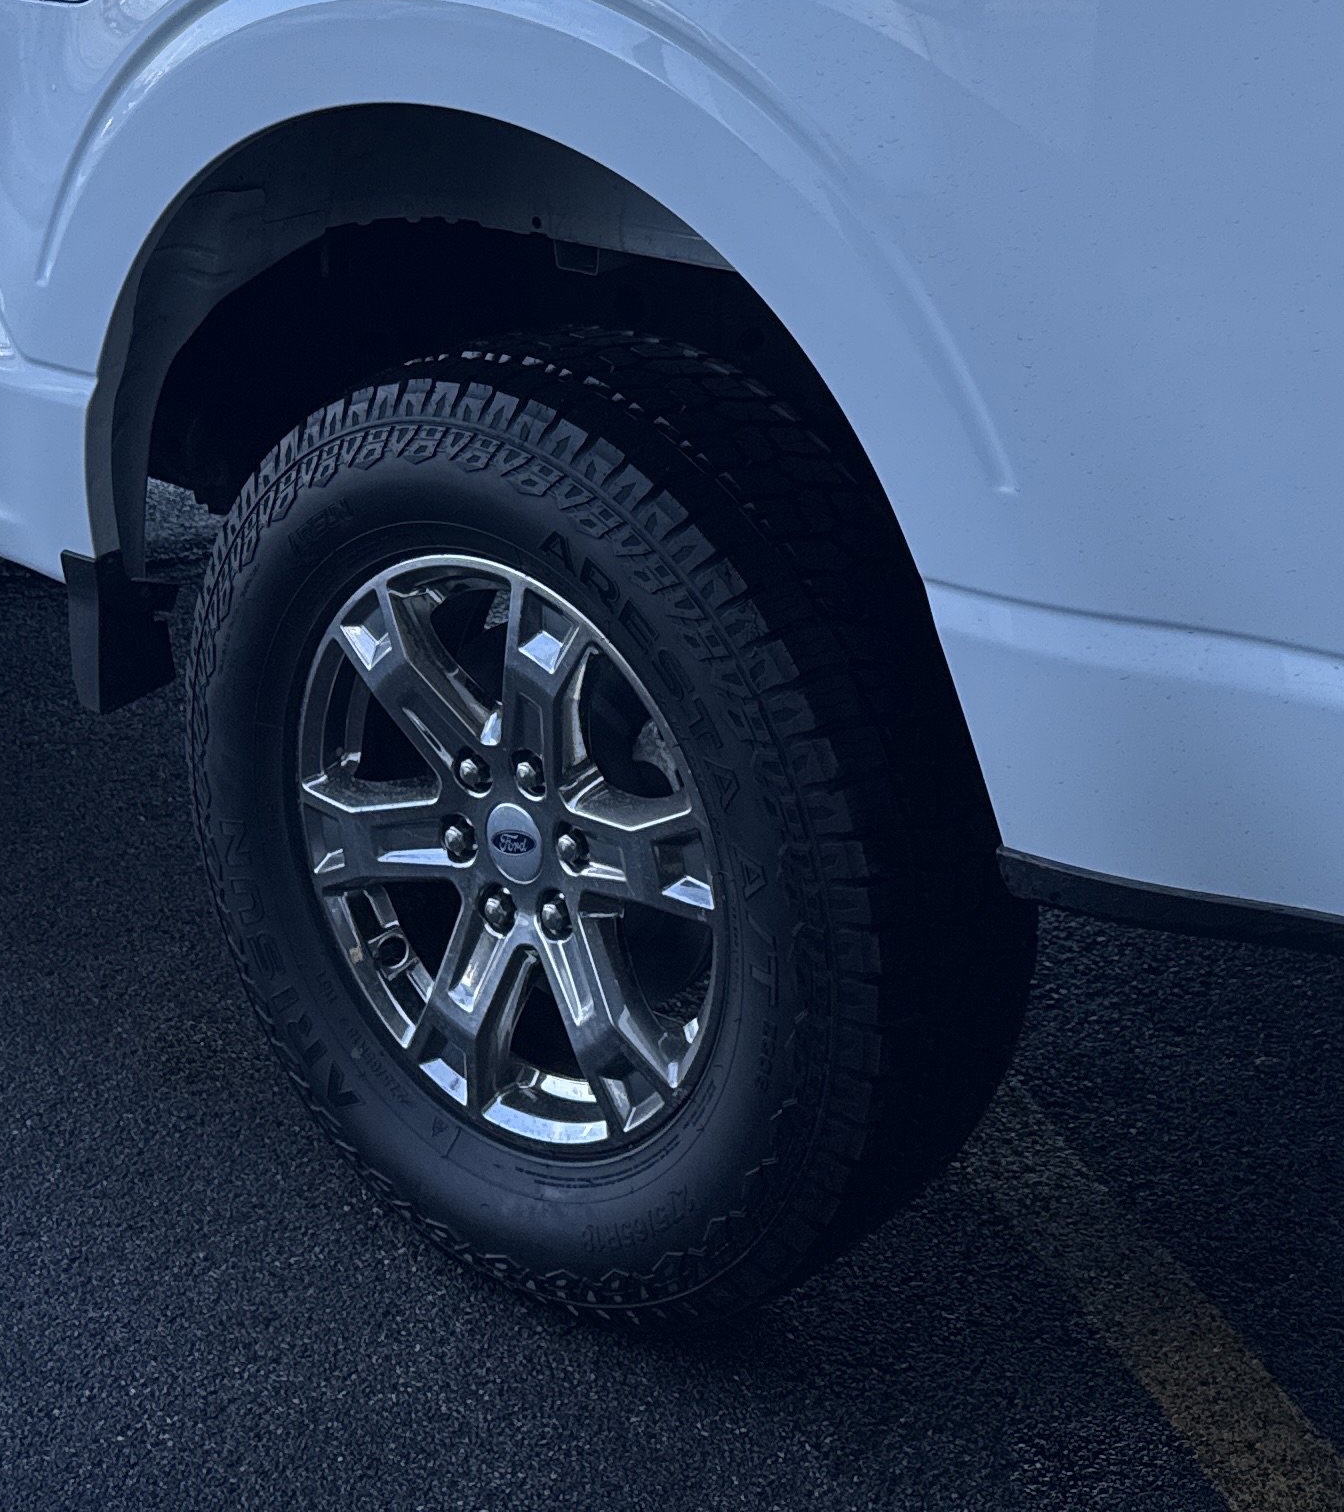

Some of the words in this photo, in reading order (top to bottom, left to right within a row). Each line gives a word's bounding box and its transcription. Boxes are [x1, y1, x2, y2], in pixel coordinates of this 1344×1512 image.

[538, 530, 742, 814] ARESTA
[218, 819, 361, 1108] ARISUN
[499, 833, 527, 852] Ford
